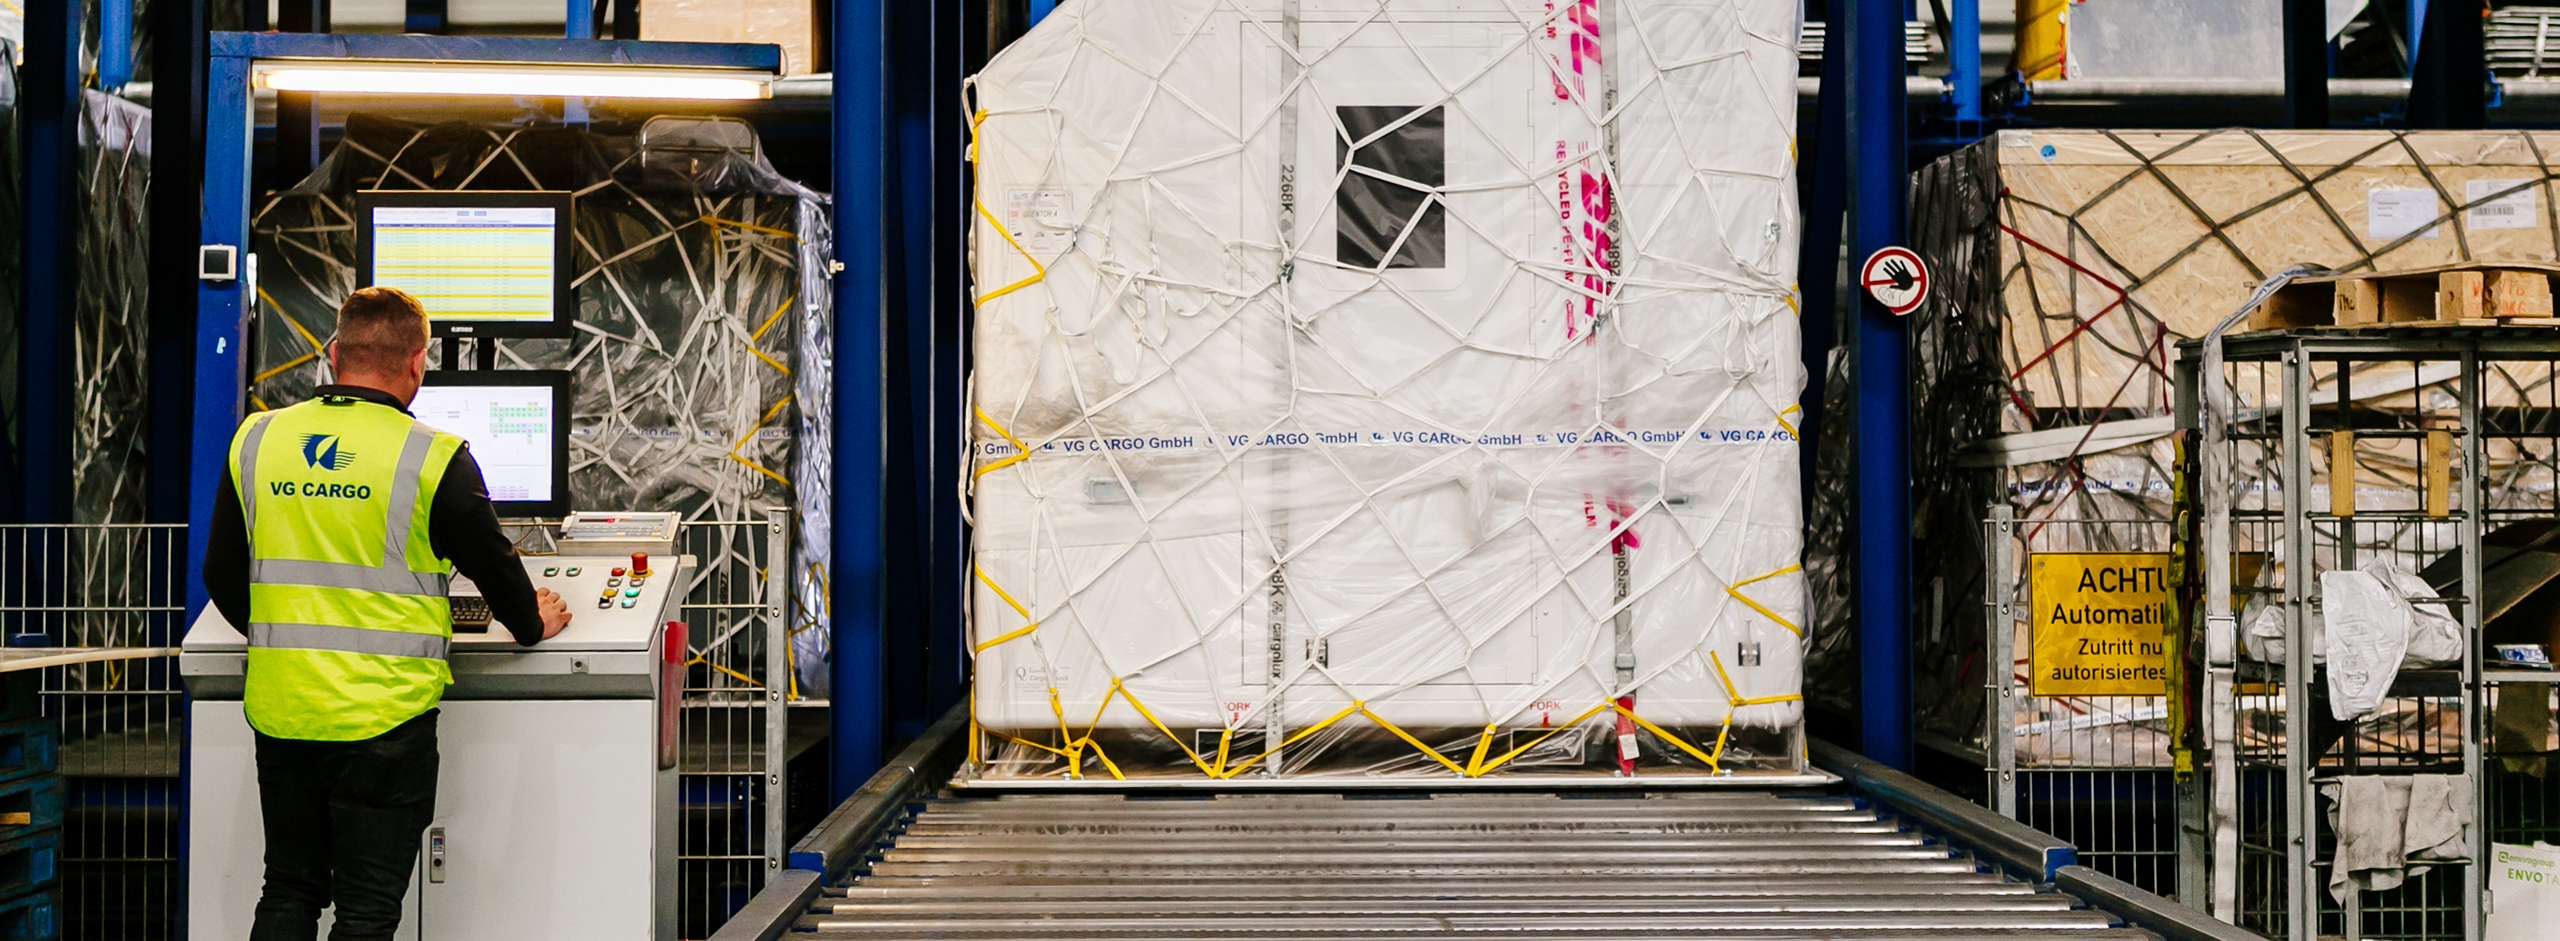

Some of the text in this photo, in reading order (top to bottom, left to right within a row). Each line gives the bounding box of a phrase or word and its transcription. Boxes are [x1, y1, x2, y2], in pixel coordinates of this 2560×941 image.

[1281, 164, 1294, 214] 2268K
[1555, 140, 1571, 220] REYCLED
[1607, 238, 1620, 288] 268K
[1064, 440, 1085, 451] VG
[1149, 437, 1193, 448] GmbH
[1228, 434, 1249, 446] VG
[1256, 433, 1309, 446] ARGO
[1393, 431, 1413, 443] VG
[1478, 434, 1522, 445] GmbH
[1556, 432, 1577, 444] VG
[1720, 430, 1741, 442] VG
[270, 481, 371, 499] VG CARGO
[1270, 622, 1283, 679] cargolux
[2078, 638, 2133, 656] Zutritt
[2051, 663, 2166, 681] autorisiertes
[1529, 701, 1562, 711] FORK
